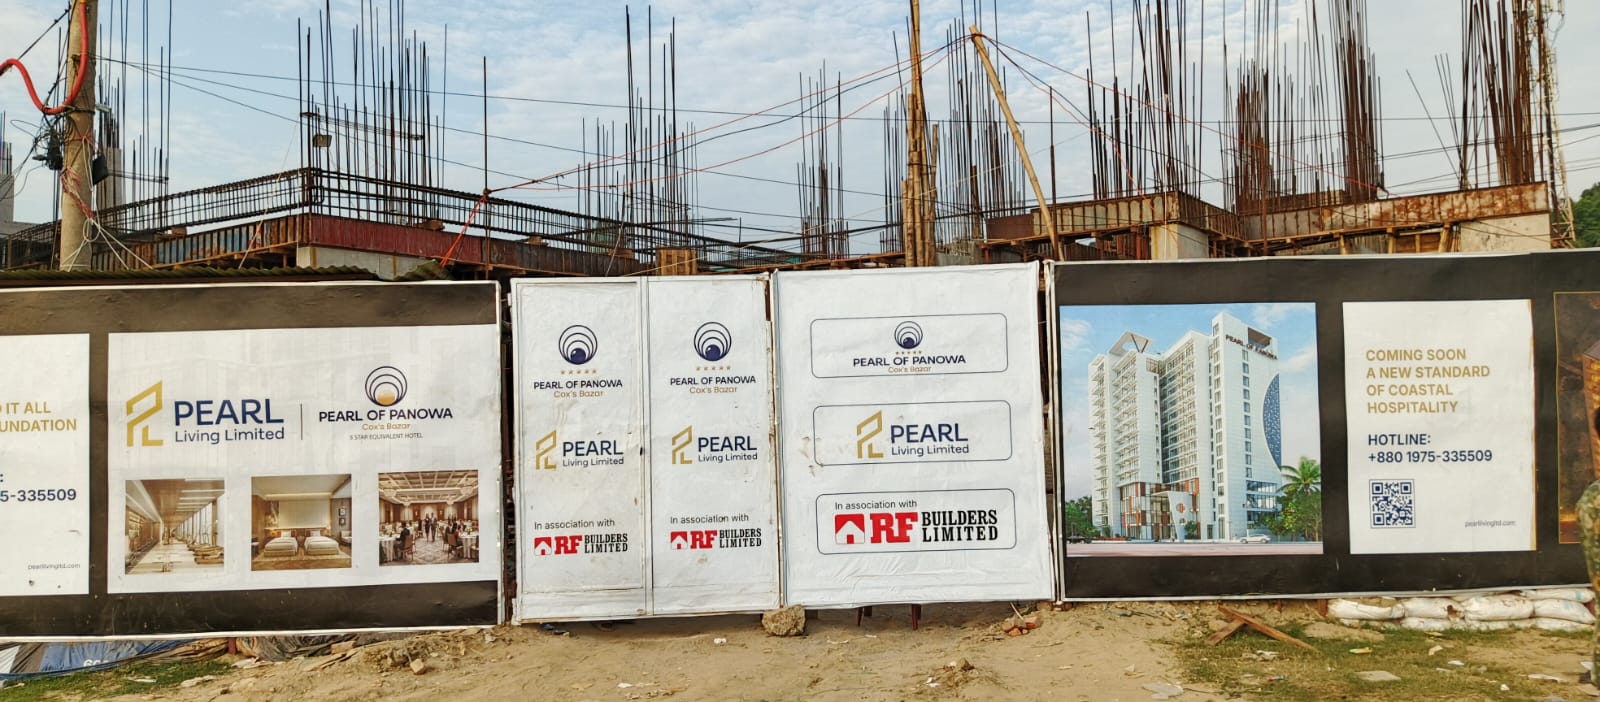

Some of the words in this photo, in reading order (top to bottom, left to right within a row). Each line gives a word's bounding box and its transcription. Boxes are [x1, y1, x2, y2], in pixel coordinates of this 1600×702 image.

[853, 357, 890, 367] PEARL
[893, 356, 909, 365] OF
[912, 355, 966, 364] PANOWA
[1366, 350, 1423, 361] COMING
[1427, 349, 1467, 361] SOON
[1366, 367, 1376, 379] A
[1379, 367, 1412, 379] NEW
[1415, 366, 1490, 378] STANDARD
[533, 381, 563, 390] PEARL
[566, 380, 578, 389] OF
[581, 379, 623, 388] PANOWA
[670, 377, 698, 386] PEARL
[701, 376, 713, 385] OF
[715, 375, 757, 384] PANOWA
[553, 391, 577, 399] Cox's
[579, 390, 604, 398] Bazar
[689, 386, 712, 394] Cox's
[1366, 384, 1385, 396] OF
[1388, 384, 1453, 396] COASTAL
[6, 402, 19, 414] IT
[24, 401, 51, 414] ALL
[174, 399, 284, 426] PEARL
[1367, 401, 1458, 413] HOSPITALITY
[319, 411, 363, 422] PEARL
[367, 409, 386, 421] OF
[389, 407, 453, 420] PANOWA
[362, 423, 385, 431] Cox's
[386, 422, 411, 430] Bazar
[175, 429, 220, 445] Living
[225, 427, 285, 441] Limited
[890, 423, 968, 443] PEARL
[1368, 433, 1431, 445] HOTLINE:
[562, 440, 624, 457] PEARL
[698, 436, 757, 452] PEARL
[891, 445, 924, 457] Living
[927, 444, 969, 454] Limited
[1368, 451, 1403, 463] +880
[1407, 449, 1492, 462] 1975-335509
[562, 459, 588, 468] Living
[591, 457, 624, 466] Limited
[698, 454, 724, 464] Living
[725, 452, 758, 461] Limited
[835, 502, 843, 510] In
[845, 500, 896, 509] association
[899, 499, 917, 508] with
[534, 522, 542, 530] In
[545, 520, 594, 529] association
[597, 518, 615, 527] with
[670, 516, 678, 524] In
[681, 515, 728, 524] association
[731, 514, 749, 522] with
[870, 512, 918, 543] RF
[922, 510, 998, 526] BUILDERS
[690, 530, 718, 549] RF
[719, 528, 762, 538] BUILDERS
[922, 526, 998, 542] LIMITED
[554, 535, 583, 554] RF
[584, 533, 628, 544] BUILDERS
[584, 543, 628, 554] LIMITED
[719, 537, 762, 549] LIMITED
